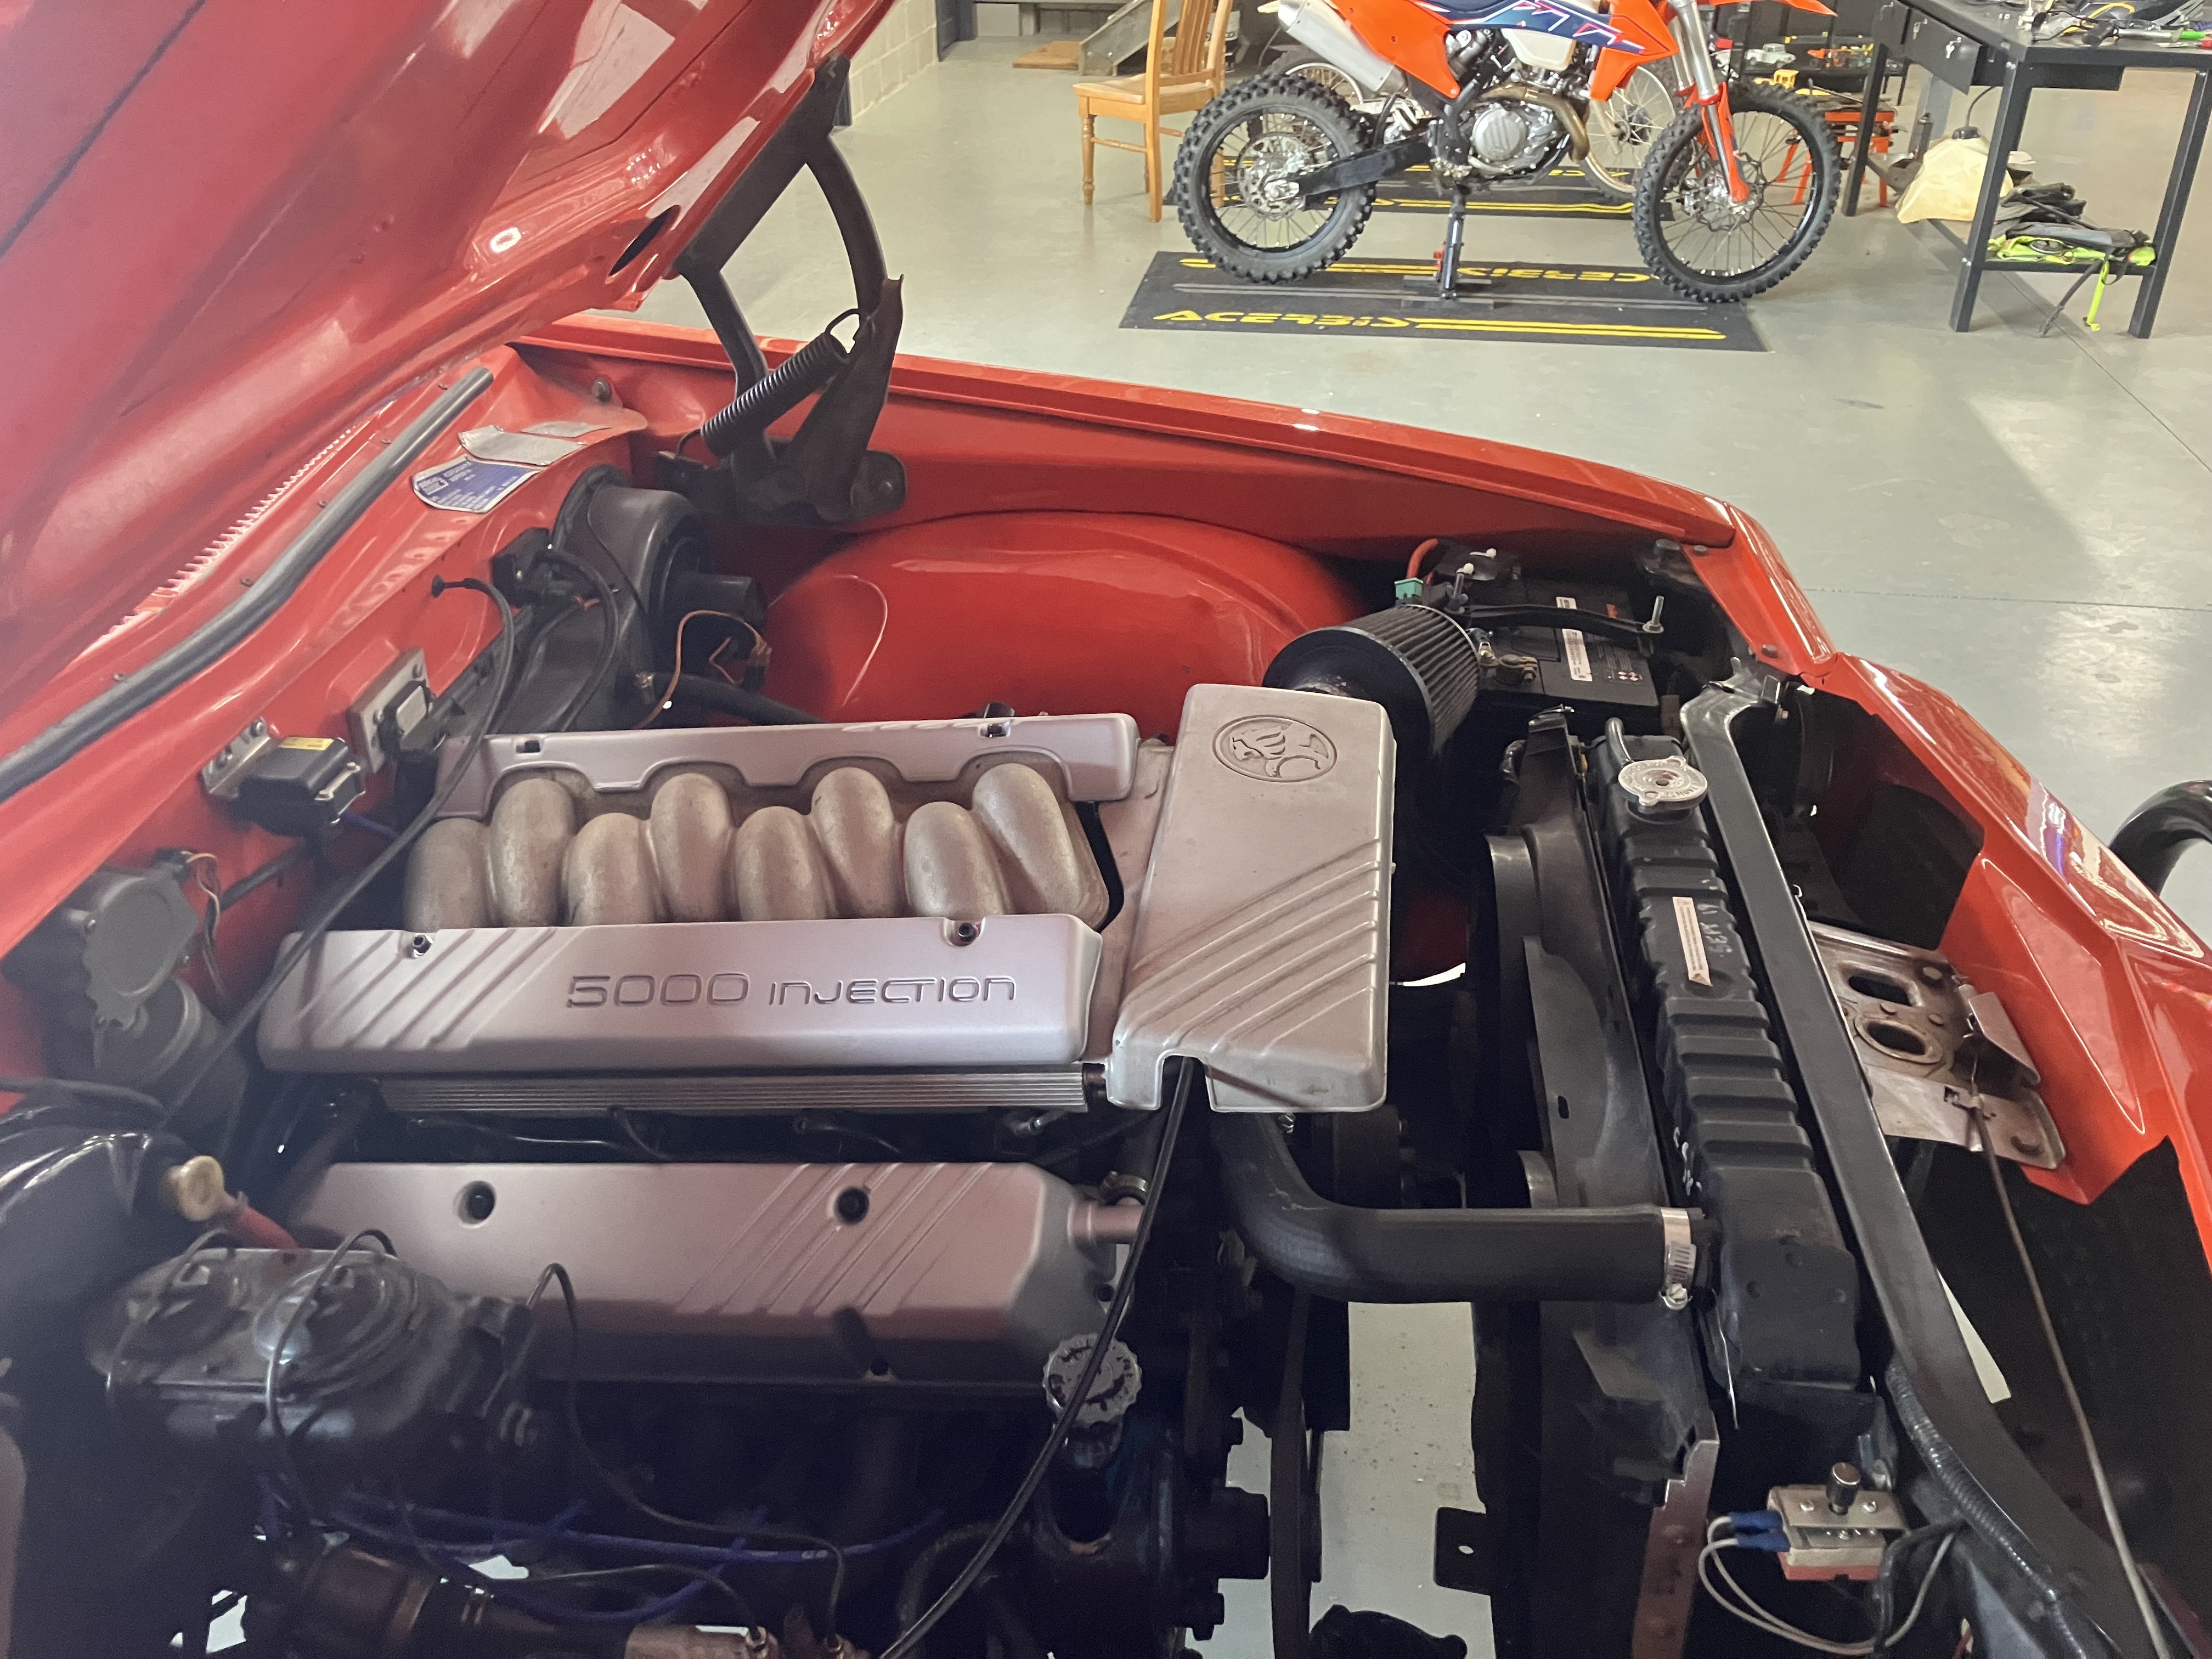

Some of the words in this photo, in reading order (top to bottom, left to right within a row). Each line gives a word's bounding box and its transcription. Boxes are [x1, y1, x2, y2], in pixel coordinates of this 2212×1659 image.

[1457, 267, 1660, 283] CERBIS
[1153, 309, 1409, 328] ACERBIS
[567, 973, 749, 1008] 5000
